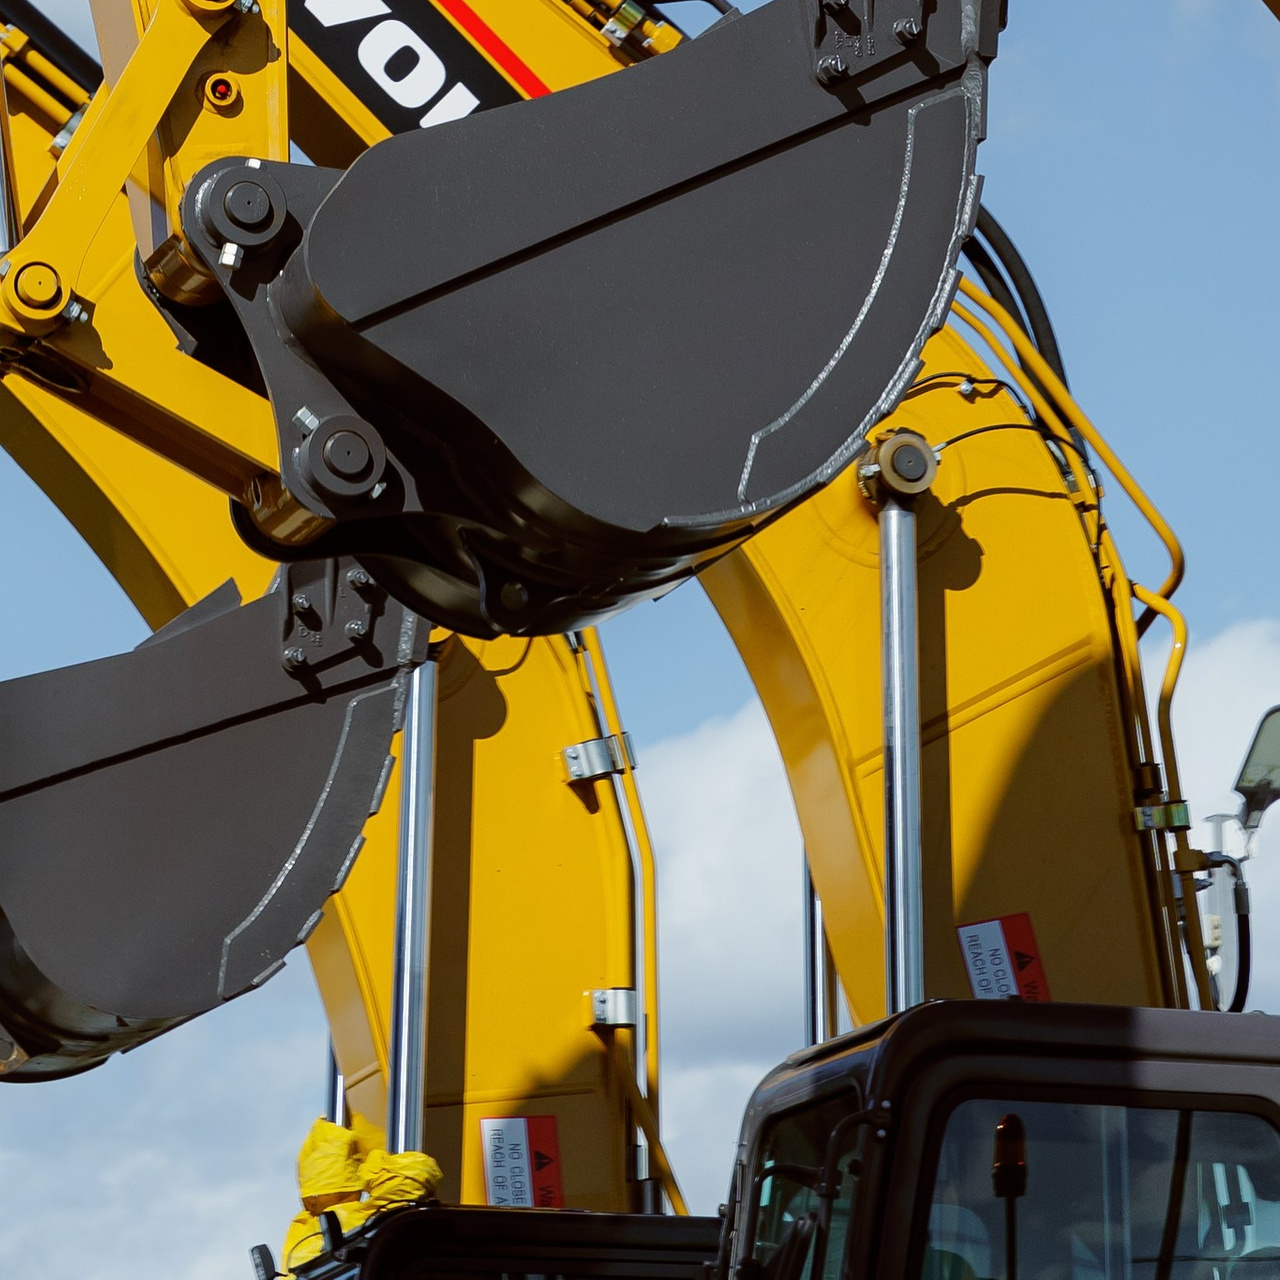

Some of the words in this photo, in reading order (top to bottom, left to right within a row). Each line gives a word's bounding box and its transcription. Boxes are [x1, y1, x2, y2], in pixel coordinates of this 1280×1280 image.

[966, 935, 987, 976] REACH
[988, 948, 1003, 966] NO
[491, 1129, 506, 1168] REACH
[508, 1143, 523, 1160] NO
[510, 1166, 526, 1204] CLOSE
